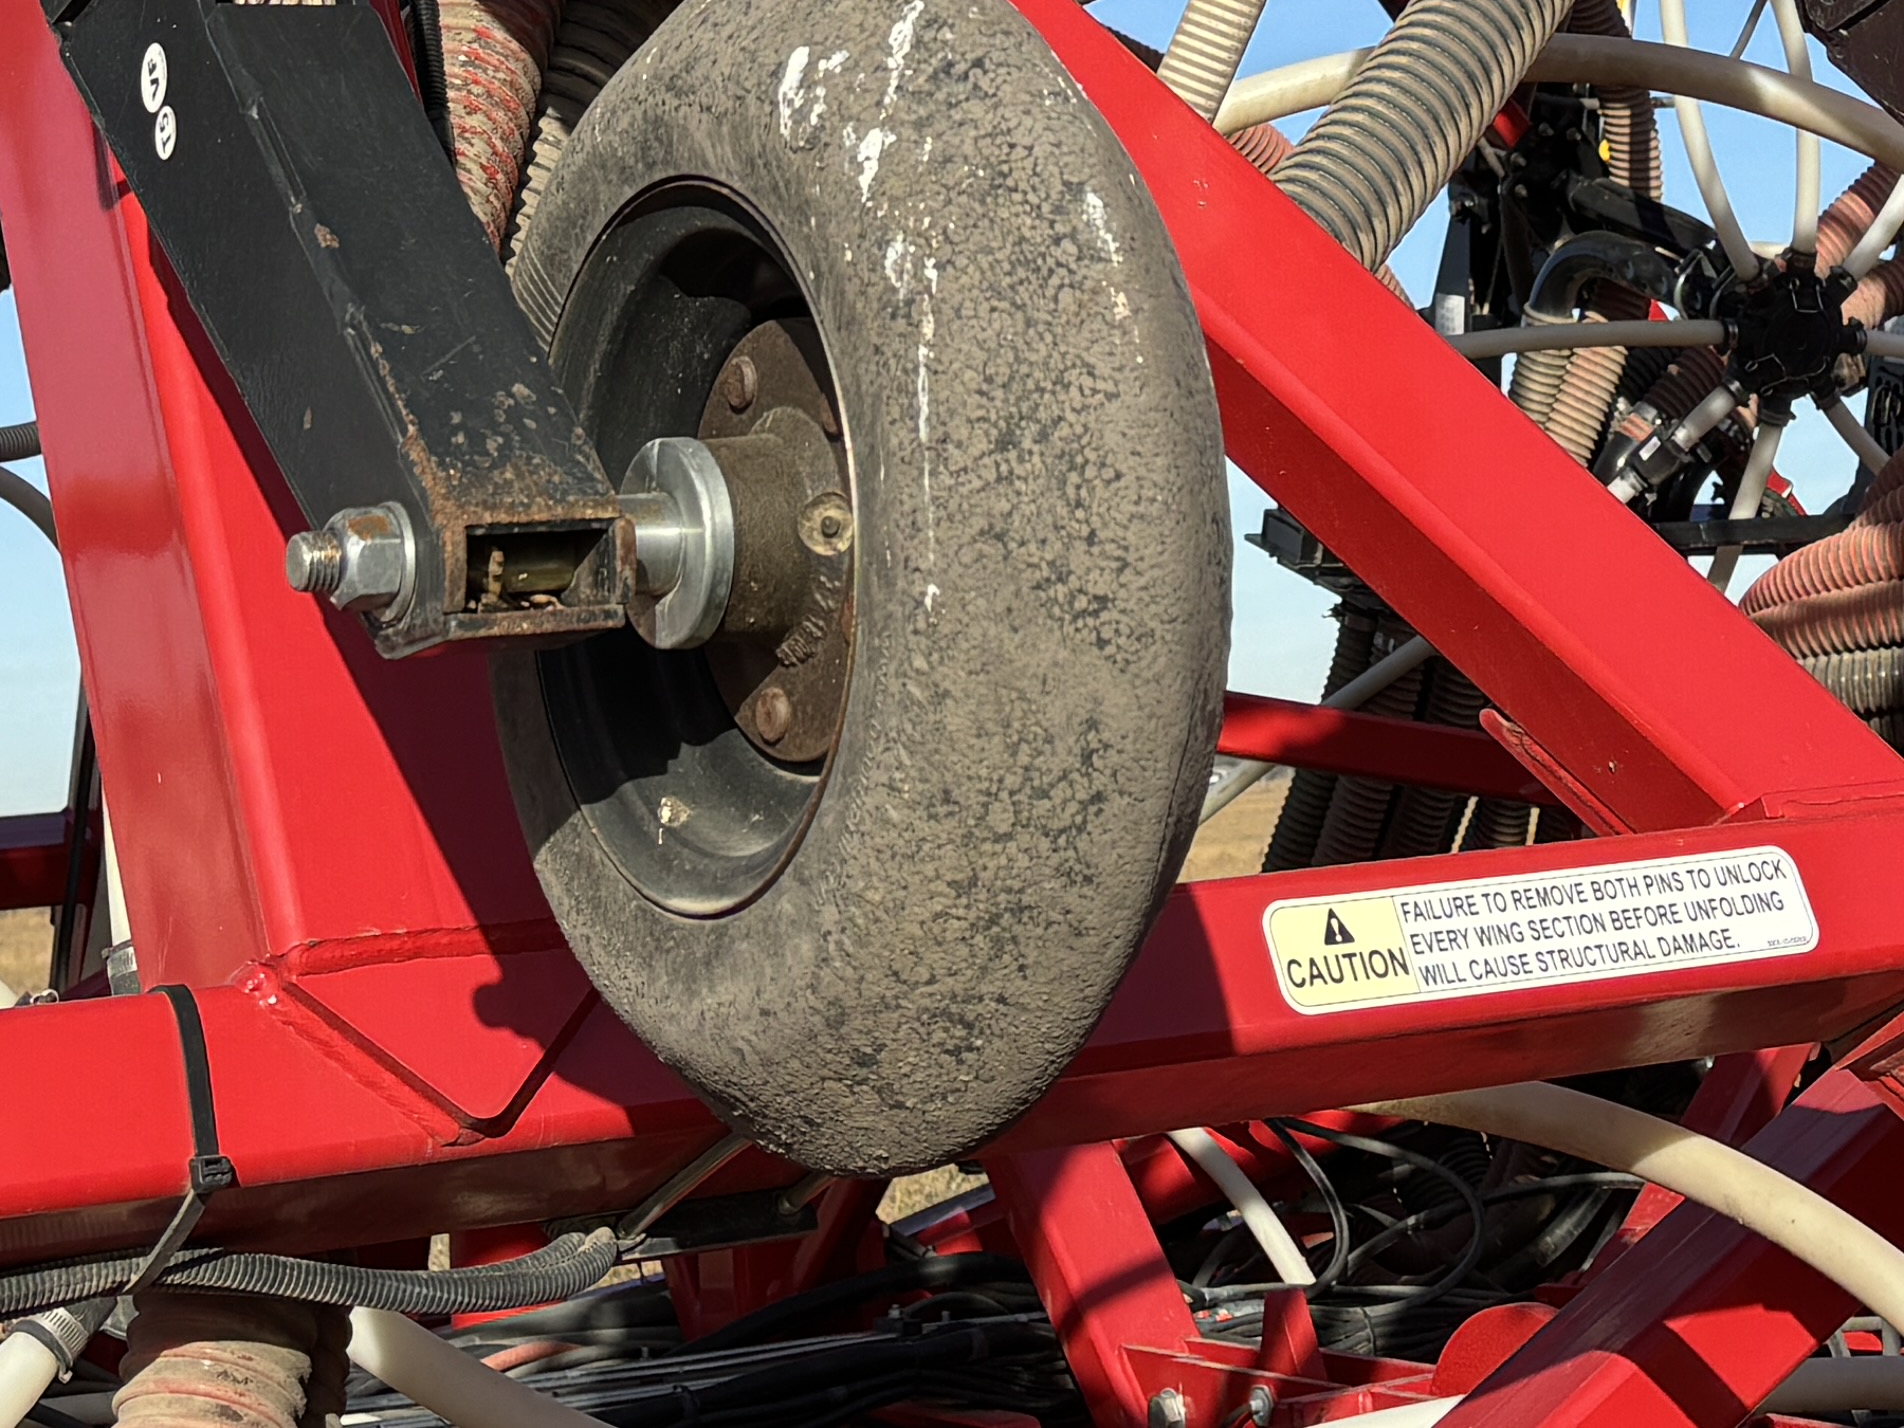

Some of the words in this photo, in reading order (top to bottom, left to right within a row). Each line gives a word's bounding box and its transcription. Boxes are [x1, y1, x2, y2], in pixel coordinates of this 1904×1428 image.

[1402, 894, 1478, 924] FAILURE
[1482, 892, 1506, 915] TO
[1512, 884, 1588, 912] REMOVE
[1592, 879, 1640, 905] BOTH
[1645, 873, 1684, 899] PINS
[1686, 870, 1710, 892] TO
[1714, 859, 1787, 888] UNLOCK
[1409, 929, 1471, 956] EVERY
[1475, 922, 1524, 947] WING
[1529, 914, 1606, 943] SECTION
[1612, 904, 1682, 932] BEFORE
[1686, 891, 1784, 925] UNFOLDING
[1286, 947, 1409, 990] CAUTION
[1418, 963, 1467, 988] WILL
[1470, 955, 1533, 982] CAUSE
[1538, 941, 1656, 975] STRUCTURAL
[1660, 928, 1741, 957] DAMAGE.
